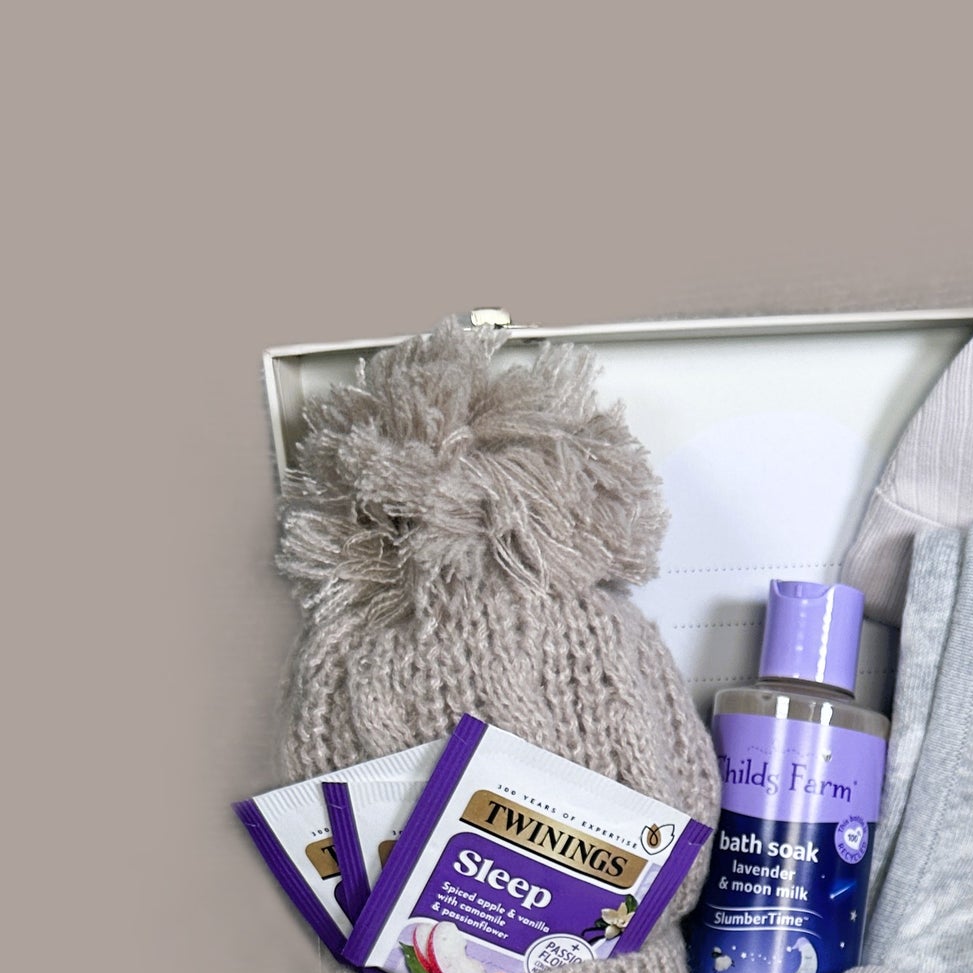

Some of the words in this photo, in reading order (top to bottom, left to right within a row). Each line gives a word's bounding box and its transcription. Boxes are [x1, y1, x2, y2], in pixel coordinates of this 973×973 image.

[485, 800, 629, 877] TWININGS
[523, 794, 556, 813] YEARS
[562, 812, 577, 822] OF
[581, 820, 638, 850] EXPERTISE
[720, 830, 762, 855] bath
[767, 841, 819, 863] soak
[453, 849, 552, 910] Sleep
[718, 876, 729, 890] &
[731, 880, 772, 895] moon
[776, 885, 809, 901] milk
[732, 860, 796, 880] lavender
[431, 901, 441, 912] &
[441, 908, 509, 940] passionflower
[437, 892, 459, 907] with
[459, 902, 506, 927] camomile
[442, 881, 477, 902] Spiced
[477, 898, 506, 915] apple
[507, 909, 517, 919] &
[518, 915, 550, 933] vanilla
